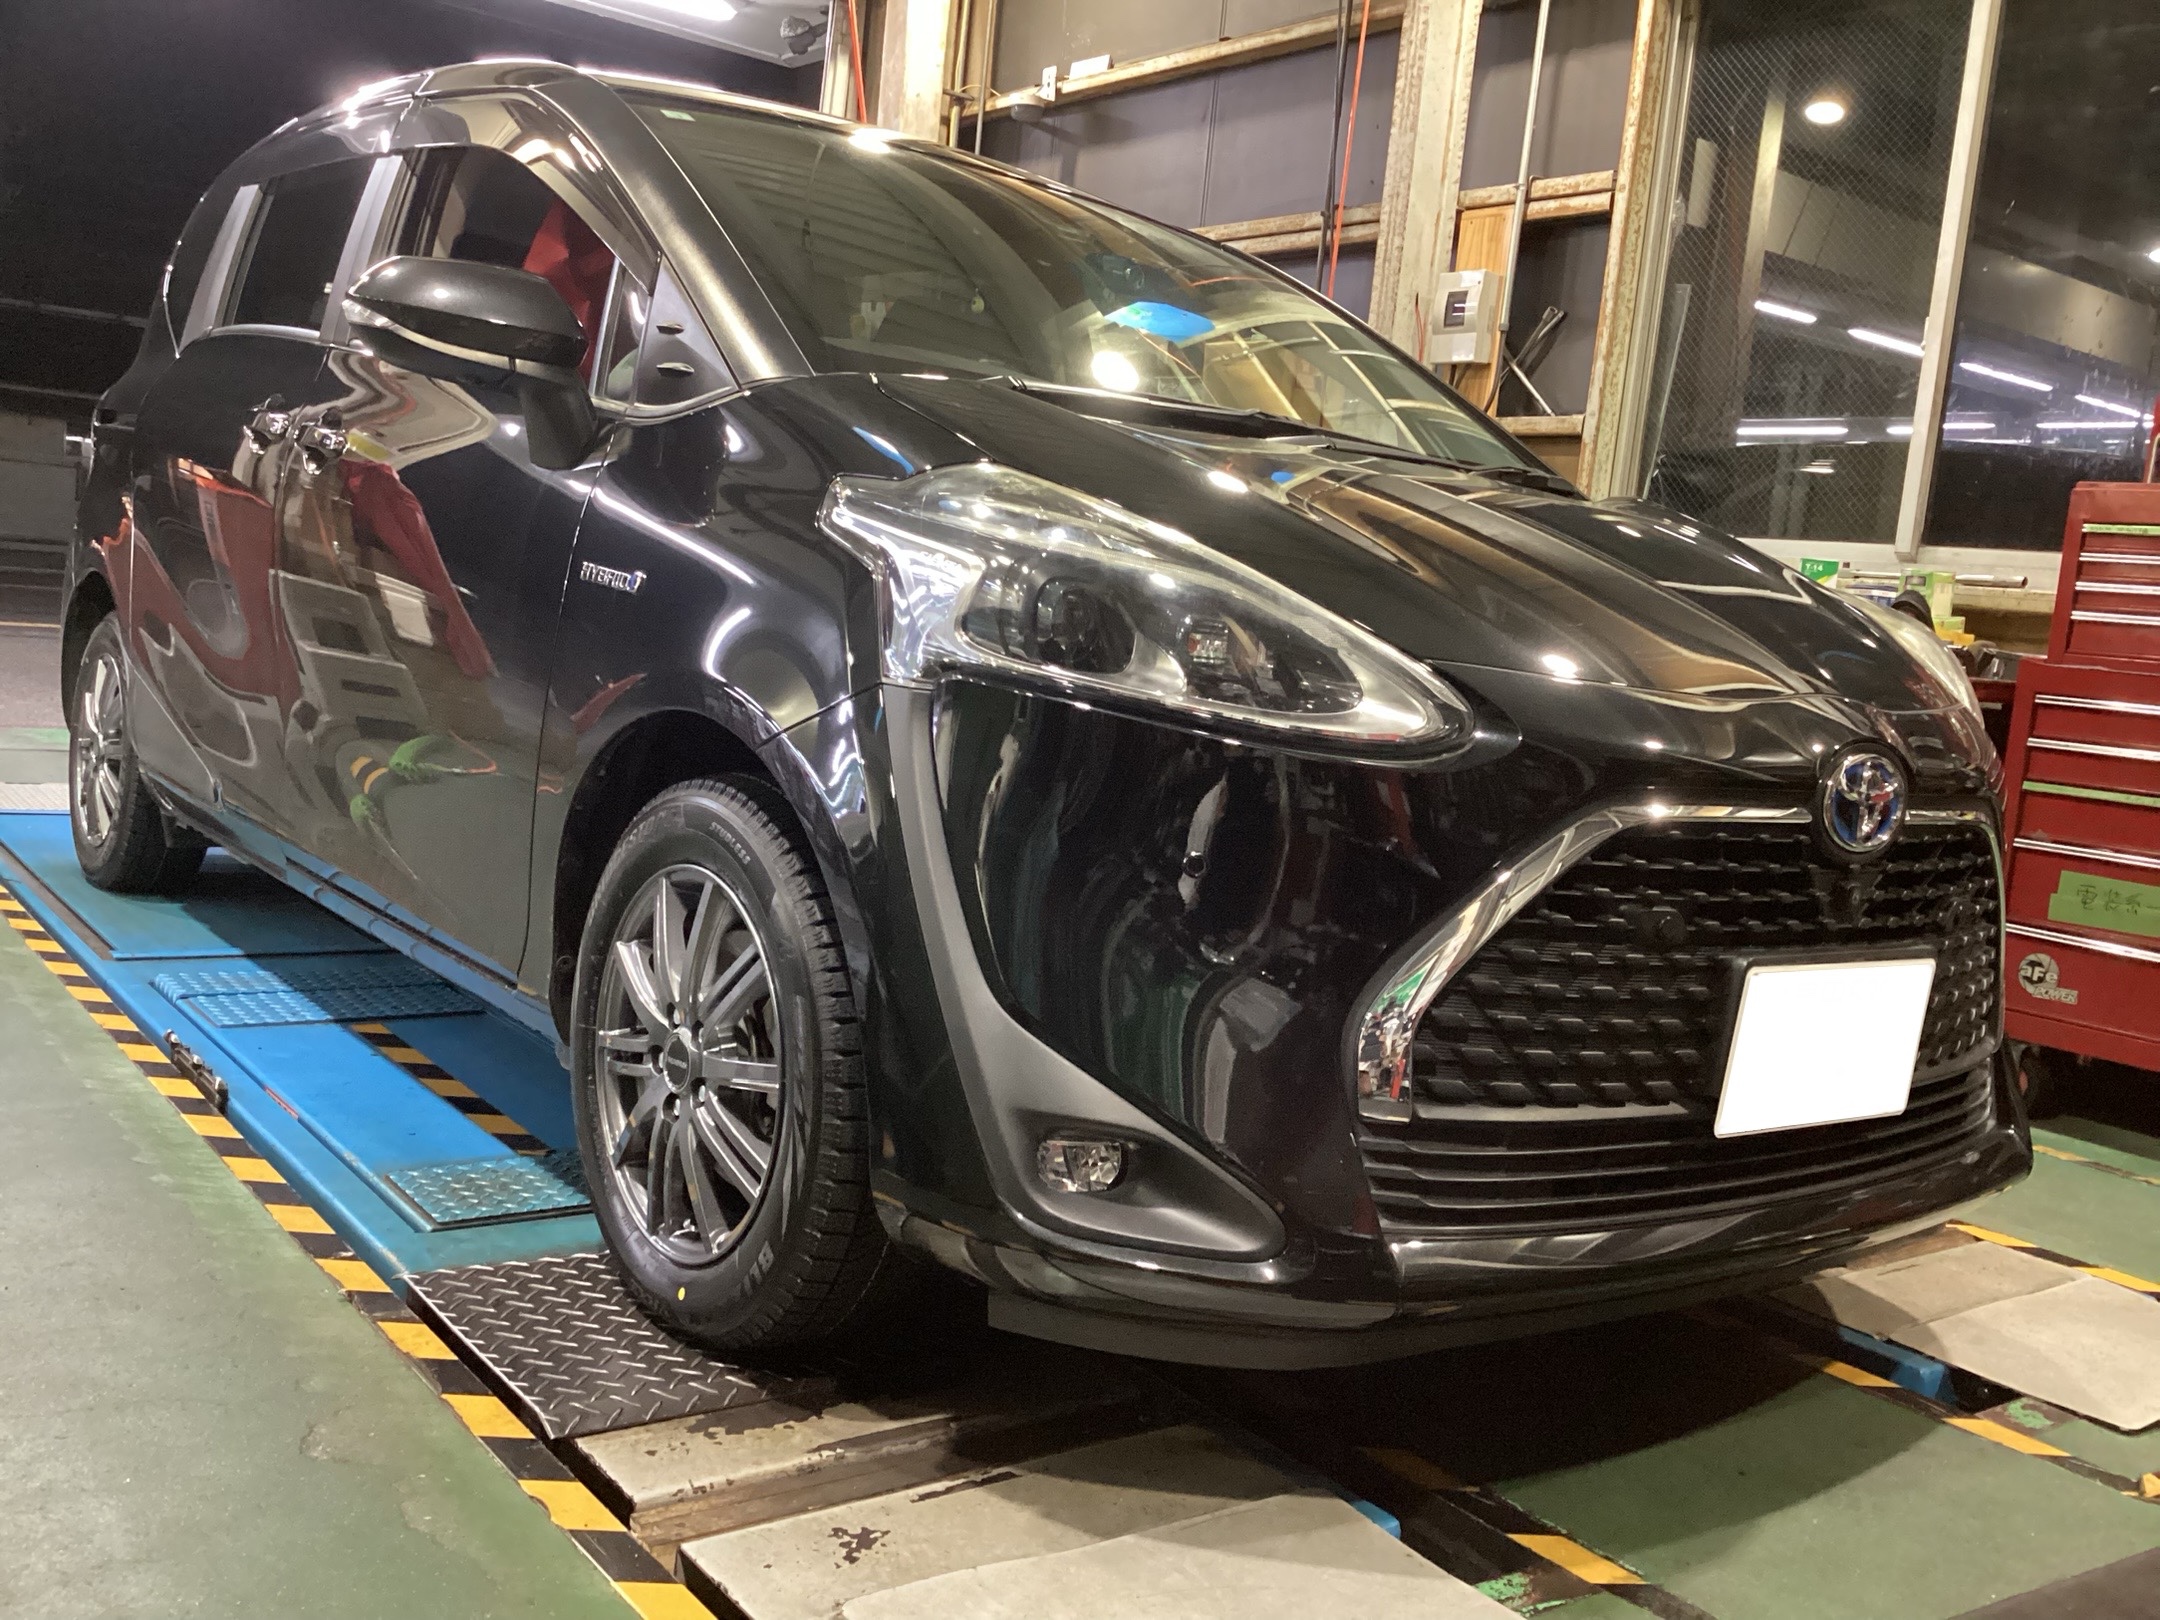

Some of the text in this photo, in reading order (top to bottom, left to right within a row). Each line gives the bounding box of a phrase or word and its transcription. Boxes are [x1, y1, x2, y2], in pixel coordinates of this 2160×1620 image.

[580, 562, 631, 591] HYBRID
[708, 821, 751, 865] STUDLESS
[2020, 965, 2058, 983] aFe
[2034, 987, 2077, 1003] POWER
